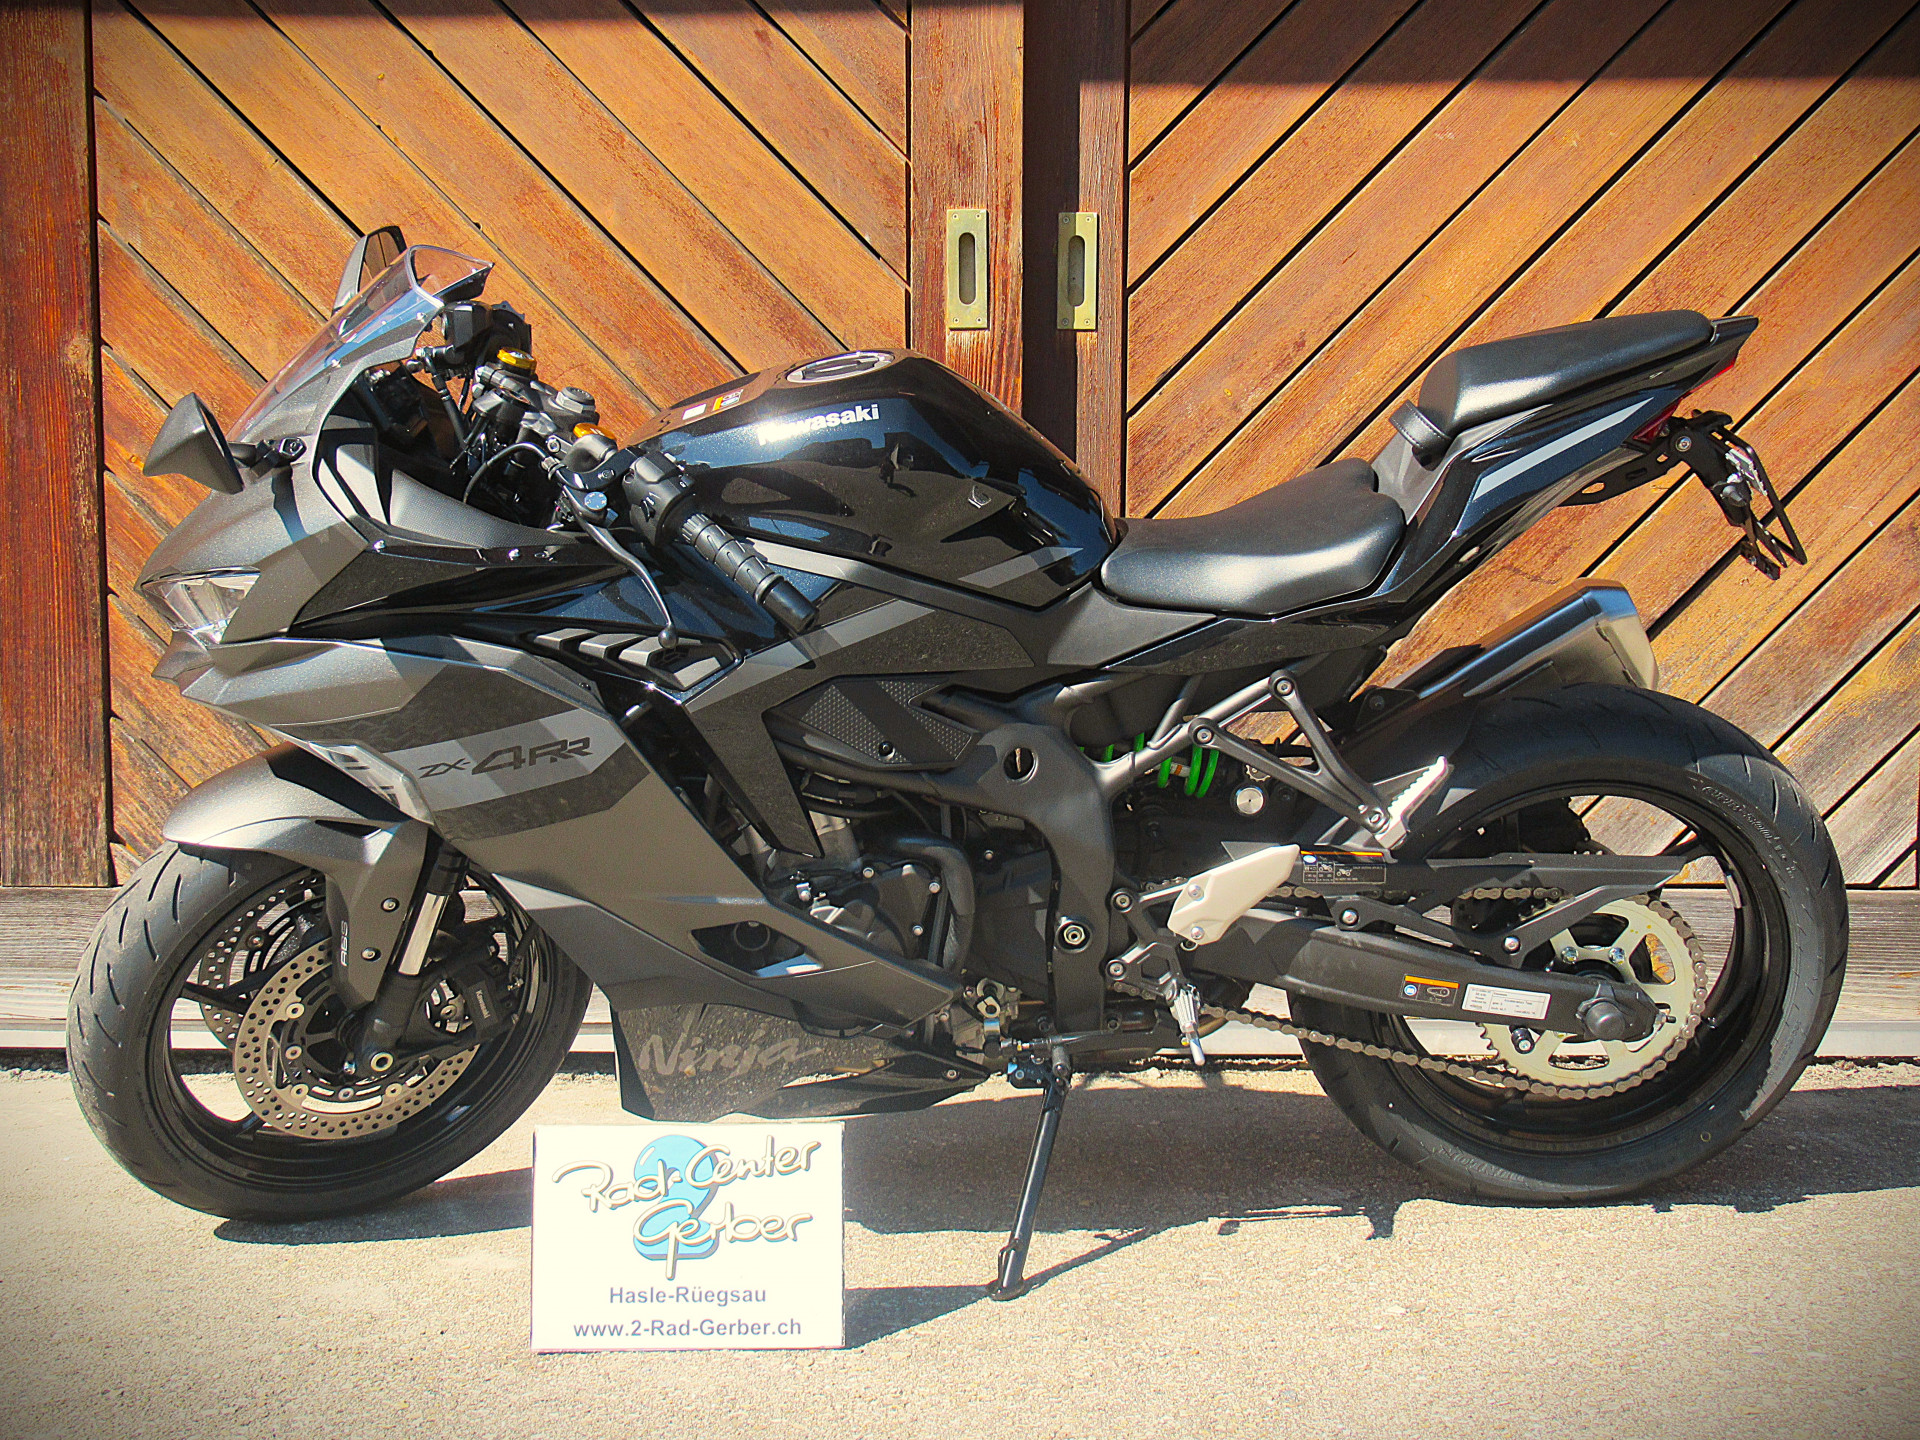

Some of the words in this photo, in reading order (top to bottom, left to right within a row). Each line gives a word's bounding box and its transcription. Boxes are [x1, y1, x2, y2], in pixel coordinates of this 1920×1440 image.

[756, 403, 881, 447] Kwasaki
[339, 920, 349, 967] ABS
[638, 1008, 825, 1088] Ninja
[632, 1198, 814, 1281] Gerber
[608, 1285, 768, 1307] Hasle-Rüegsau
[573, 1318, 803, 1338] www.2-Rad-Gerber.ch
